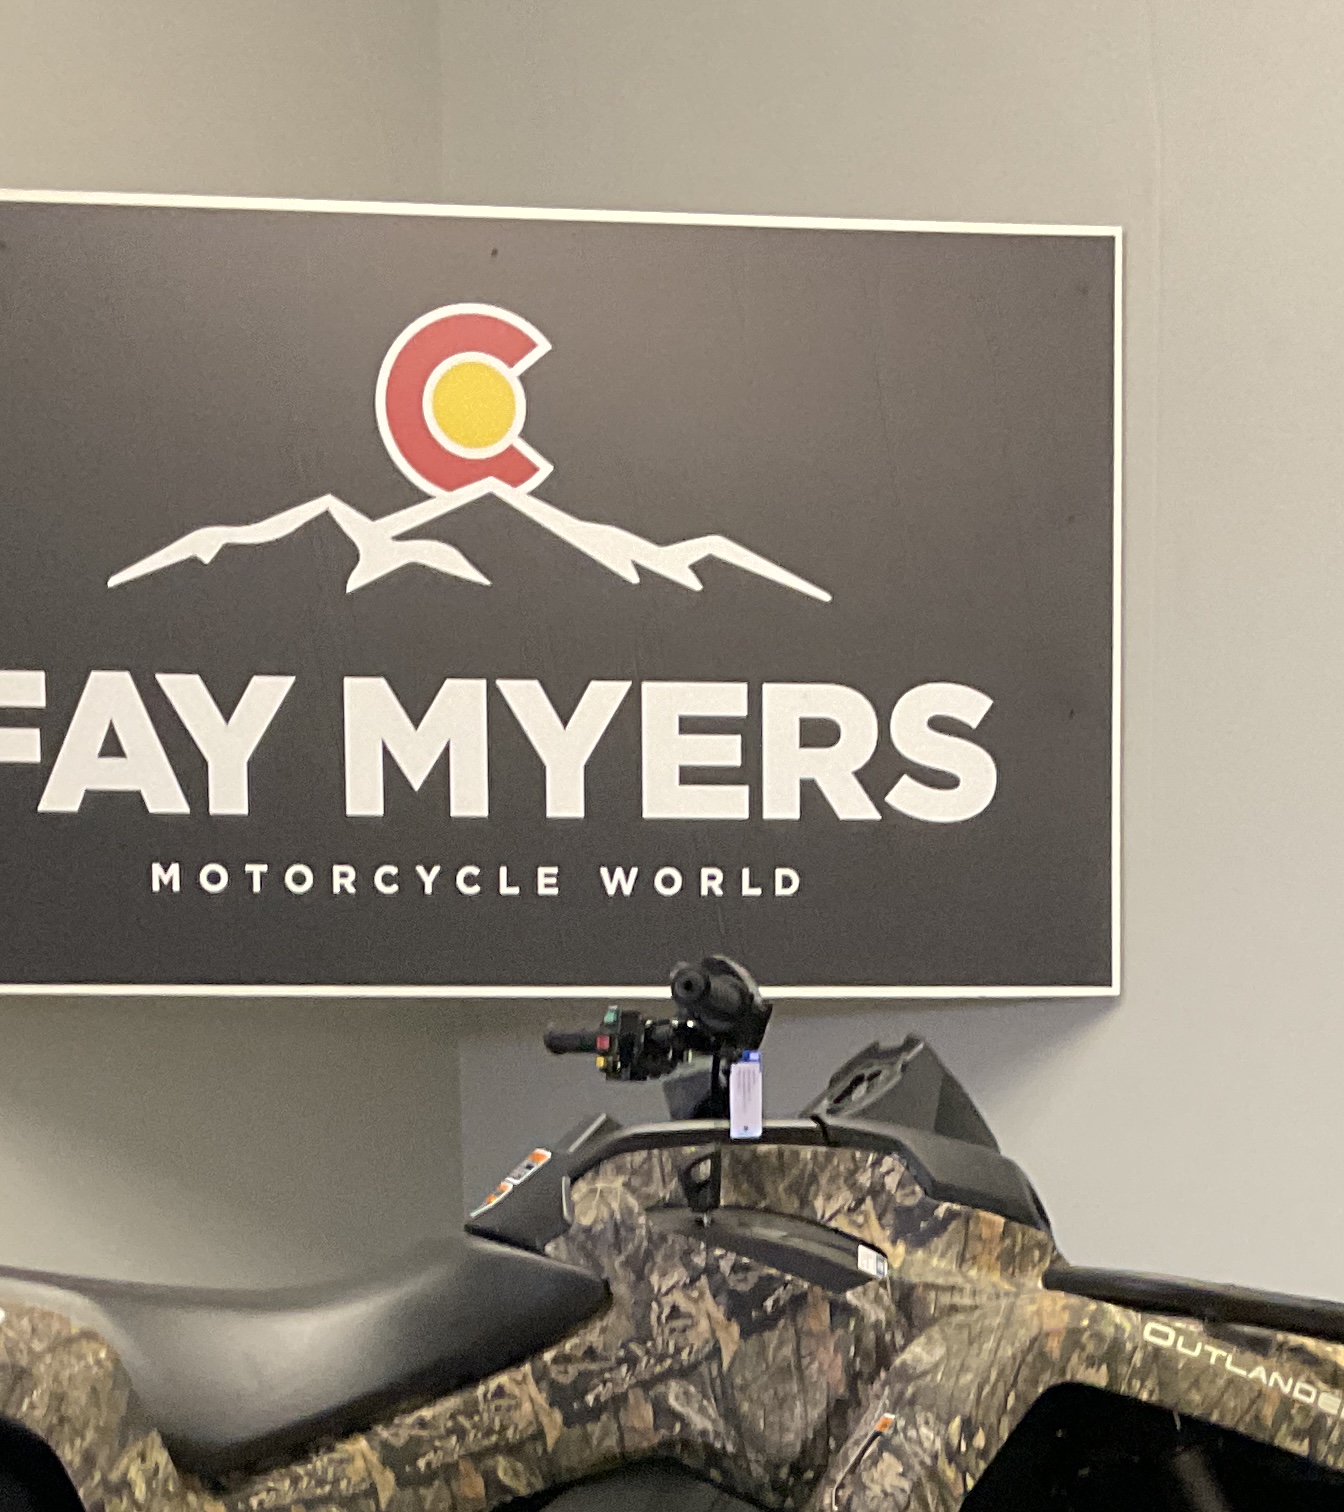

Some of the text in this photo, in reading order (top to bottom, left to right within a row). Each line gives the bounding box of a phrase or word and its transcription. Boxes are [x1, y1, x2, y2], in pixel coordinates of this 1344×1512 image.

[343, 675, 998, 823] MYERS
[151, 862, 804, 898] MOTORCYCLE WORLD
